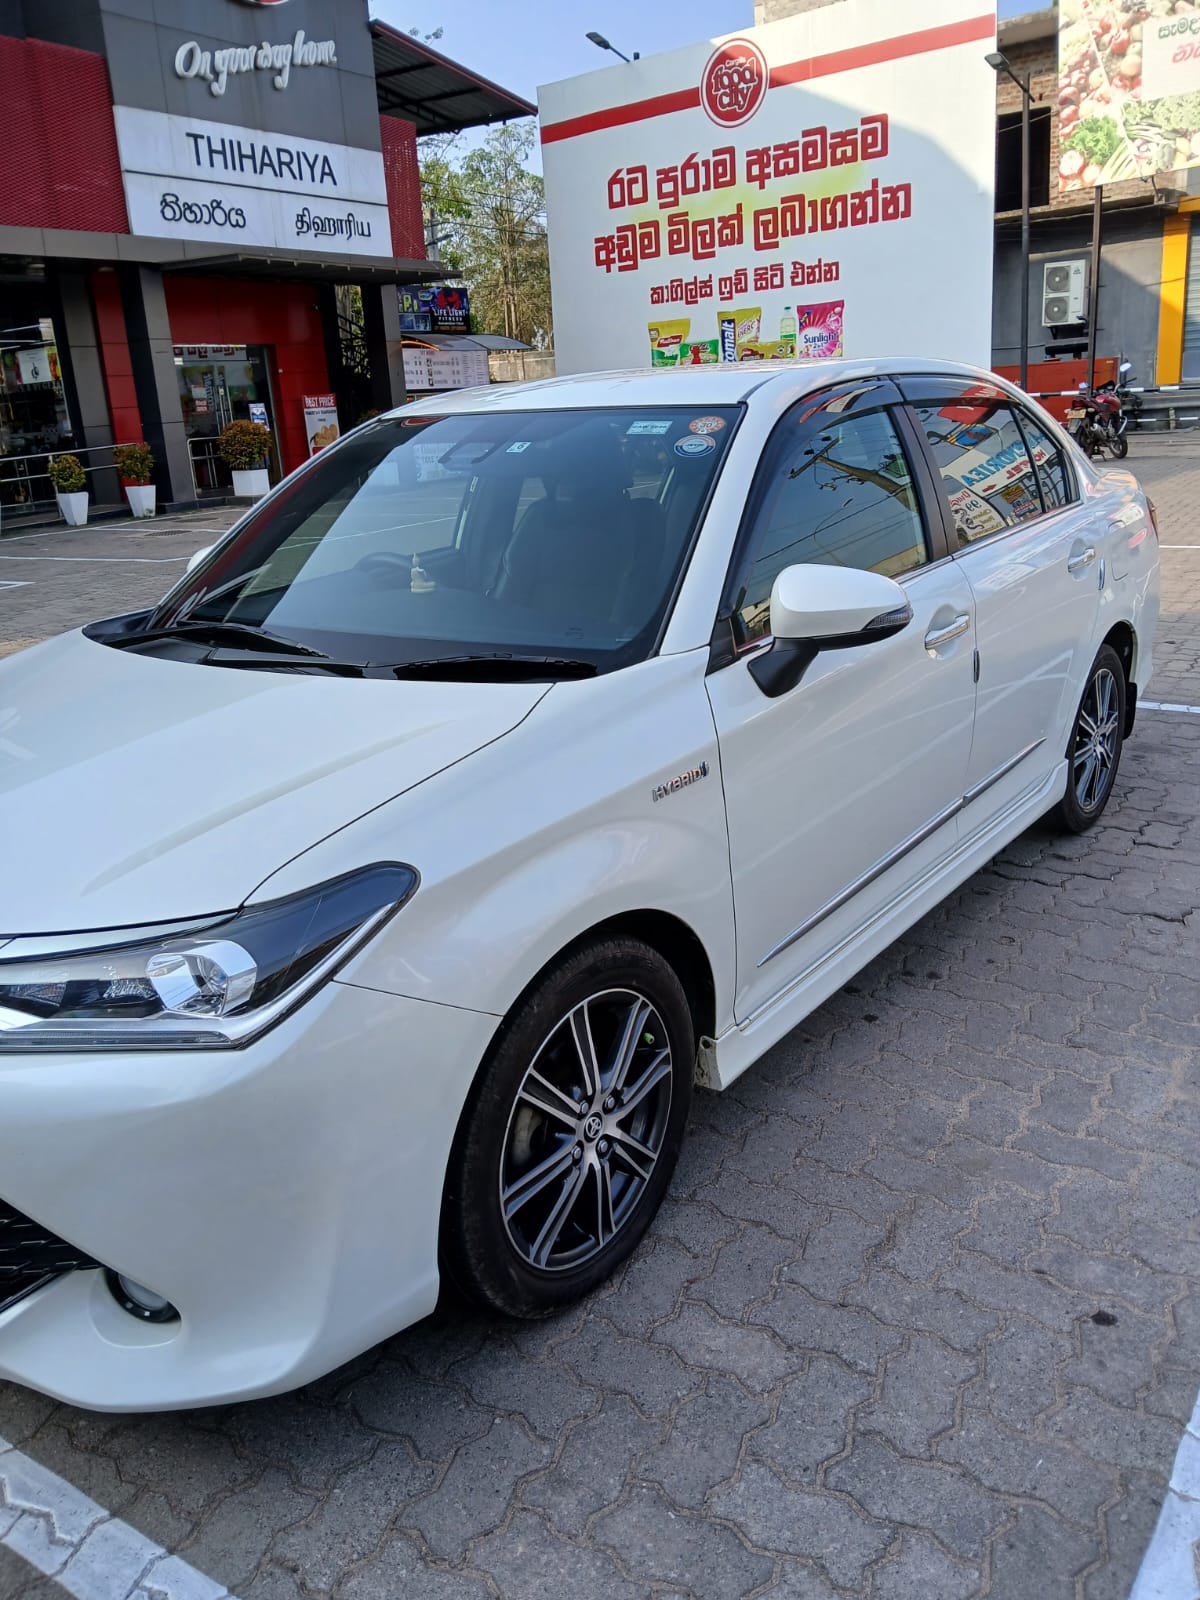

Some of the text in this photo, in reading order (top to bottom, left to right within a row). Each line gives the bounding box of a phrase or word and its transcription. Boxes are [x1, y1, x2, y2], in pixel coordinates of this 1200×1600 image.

[1158, 17, 1200, 39] සැමද
[175, 41, 214, 79] On
[211, 45, 257, 96] your
[293, 29, 337, 66] home
[712, 57, 758, 94] food
[717, 84, 753, 112] city
[185, 132, 337, 186] THIHARIYA
[607, 113, 889, 209] රට පුරාම අසමසම
[160, 192, 246, 228] තිහාරිය
[295, 207, 371, 240] திஹாரிய
[594, 178, 912, 273] අඩුම මිලක් ලබාගන්න
[650, 258, 840, 305] කාගිල්ස් ෆුඩ් සිටි එන්න
[434, 308, 466, 317] LIFE LIGHT
[804, 332, 837, 345] Sunlight
[305, 395, 335, 407] BEST PRICE
[651, 767, 703, 802] HYBRID
